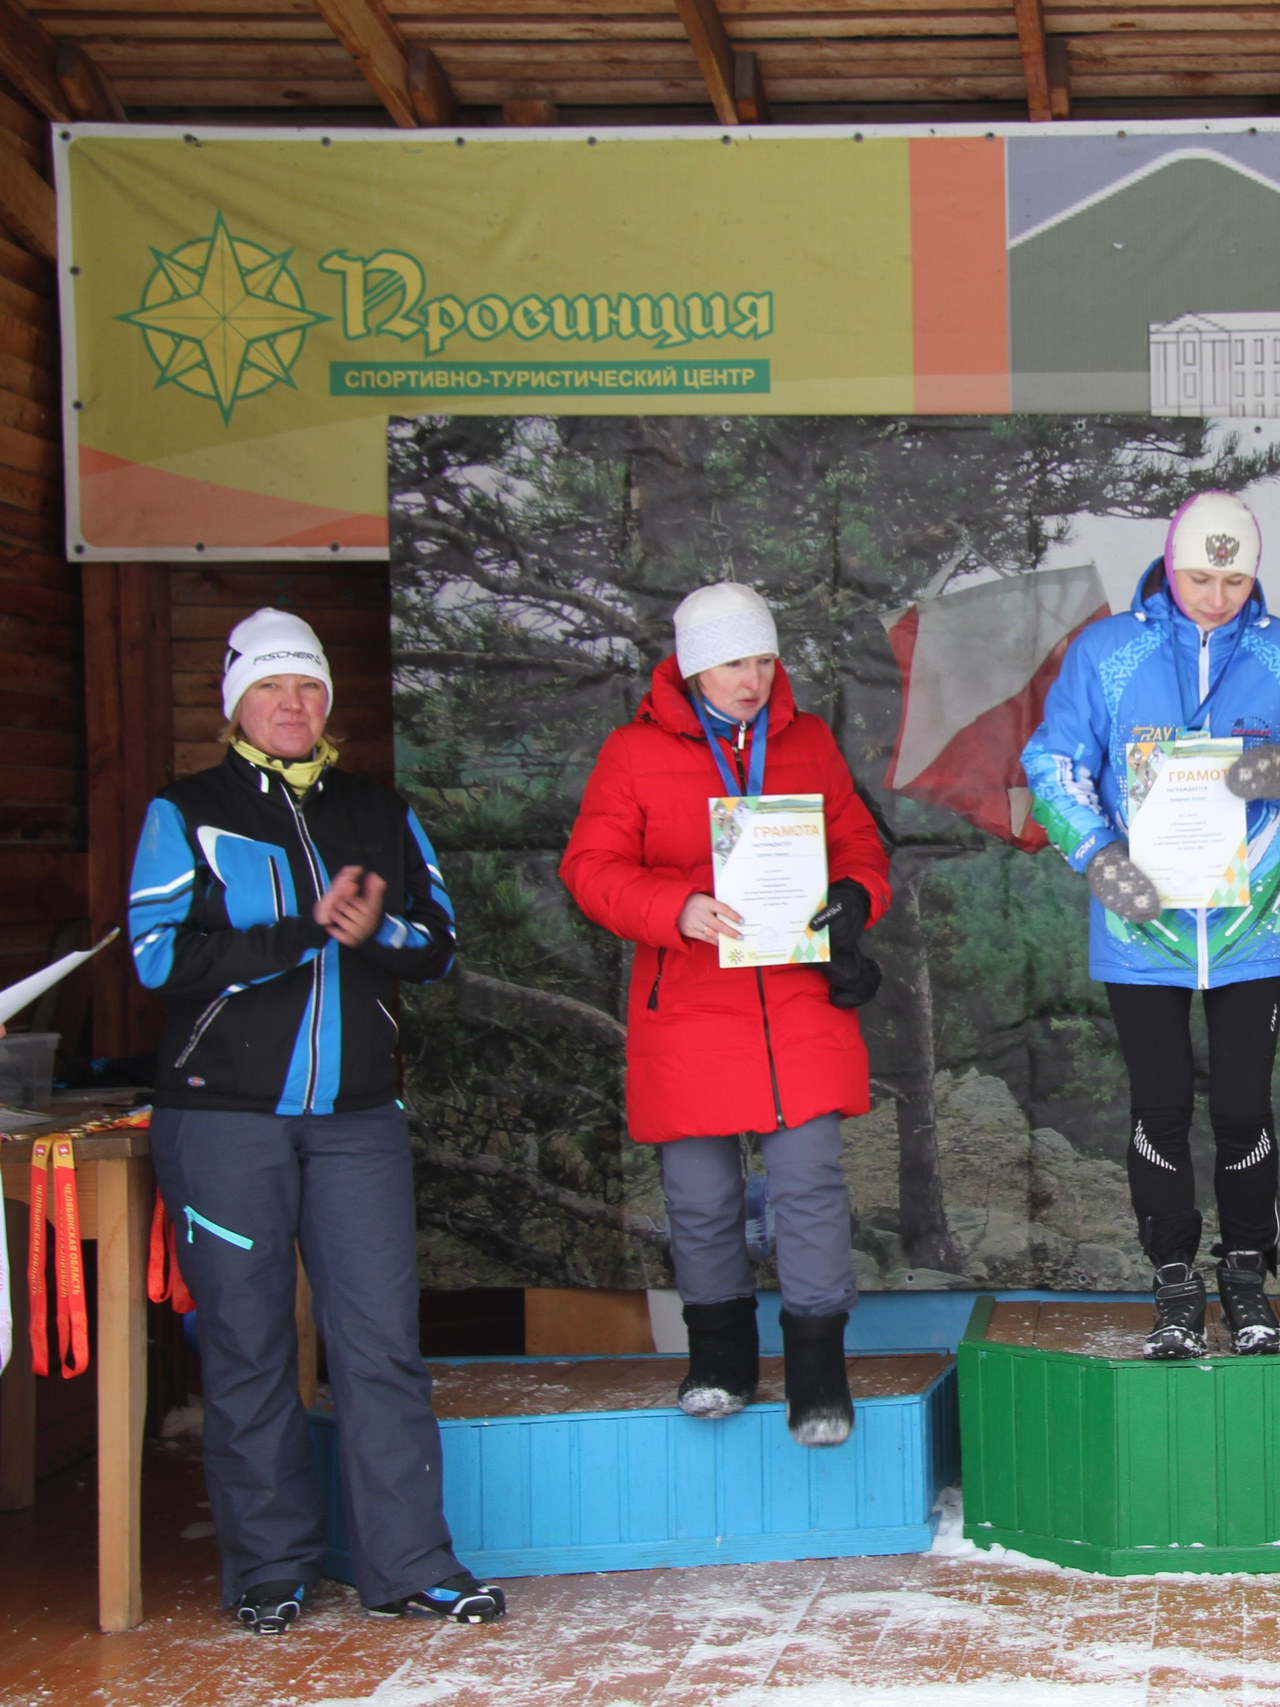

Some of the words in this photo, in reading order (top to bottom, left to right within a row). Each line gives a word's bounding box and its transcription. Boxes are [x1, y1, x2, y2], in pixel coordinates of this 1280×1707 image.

[318, 249, 773, 357] Провинция
[344, 366, 677, 389] СПОРТИВНО-ТУРИСТИЧЕСКИЙ
[683, 367, 756, 389] ЦЕНТР
[1132, 726, 1173, 741] RAY
[1168, 768, 1228, 783] ГРАМОТ
[753, 824, 820, 838] ГРАМОТА
[33, 1184, 43, 1253] ЧЕЛЯБИНСКАЯ
[64, 1183, 77, 1251] ЧЕЛЯБИНСКАЯ
[69, 1252, 81, 1295] ОБЛАСТЬ
